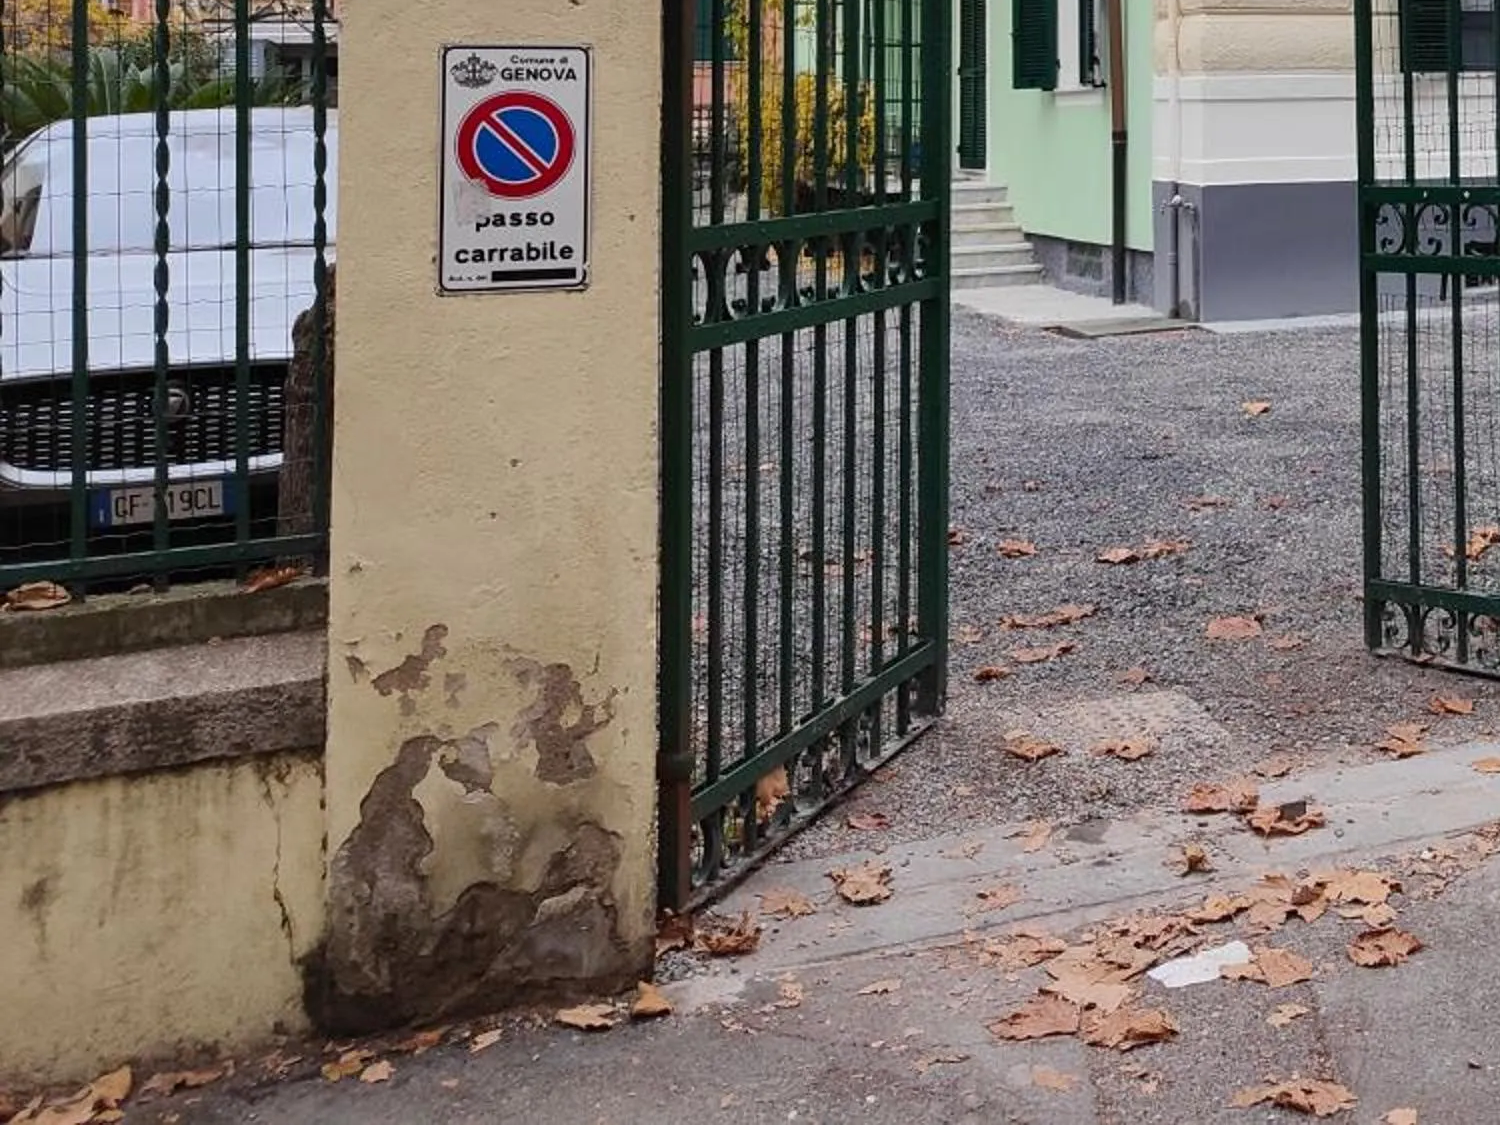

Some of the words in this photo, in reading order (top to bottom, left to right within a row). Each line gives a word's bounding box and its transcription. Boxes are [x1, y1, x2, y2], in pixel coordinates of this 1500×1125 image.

[510, 54, 555, 64] Comune
[559, 56, 569, 64] di
[500, 67, 577, 82] GENOVA
[475, 211, 555, 233] passo
[454, 240, 575, 264] carrabile
